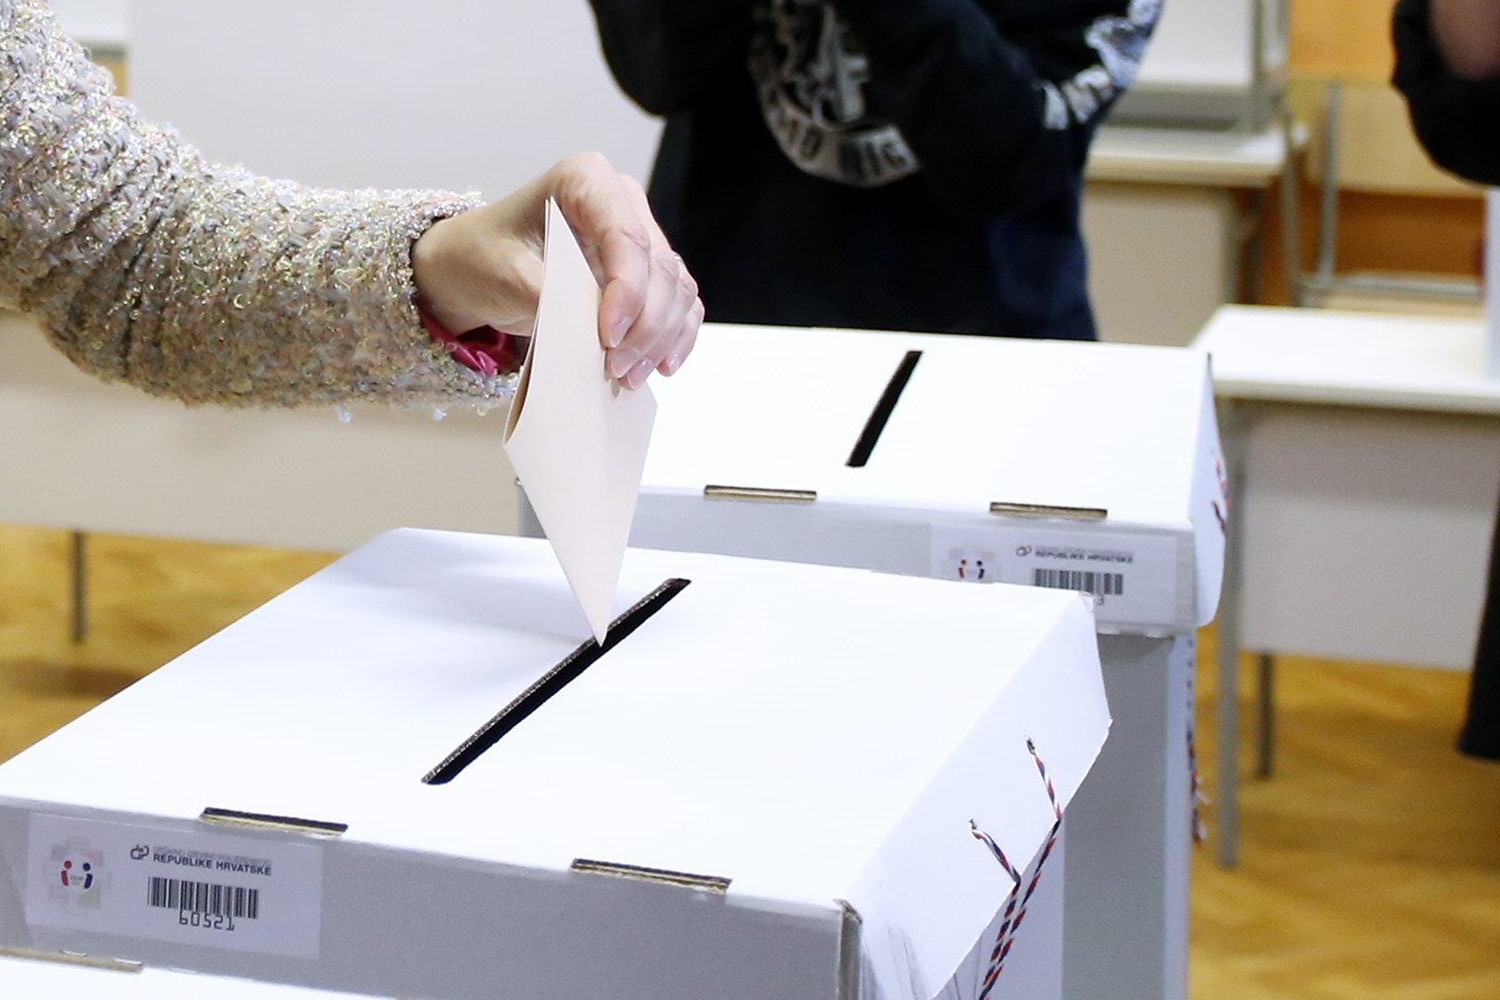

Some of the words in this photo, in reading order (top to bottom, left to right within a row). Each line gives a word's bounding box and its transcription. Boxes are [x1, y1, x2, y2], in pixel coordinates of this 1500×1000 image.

[153, 853, 213, 869] REPUBLIKE
[215, 861, 272, 876] HRVATSKE
[179, 909, 235, 931] 60521
